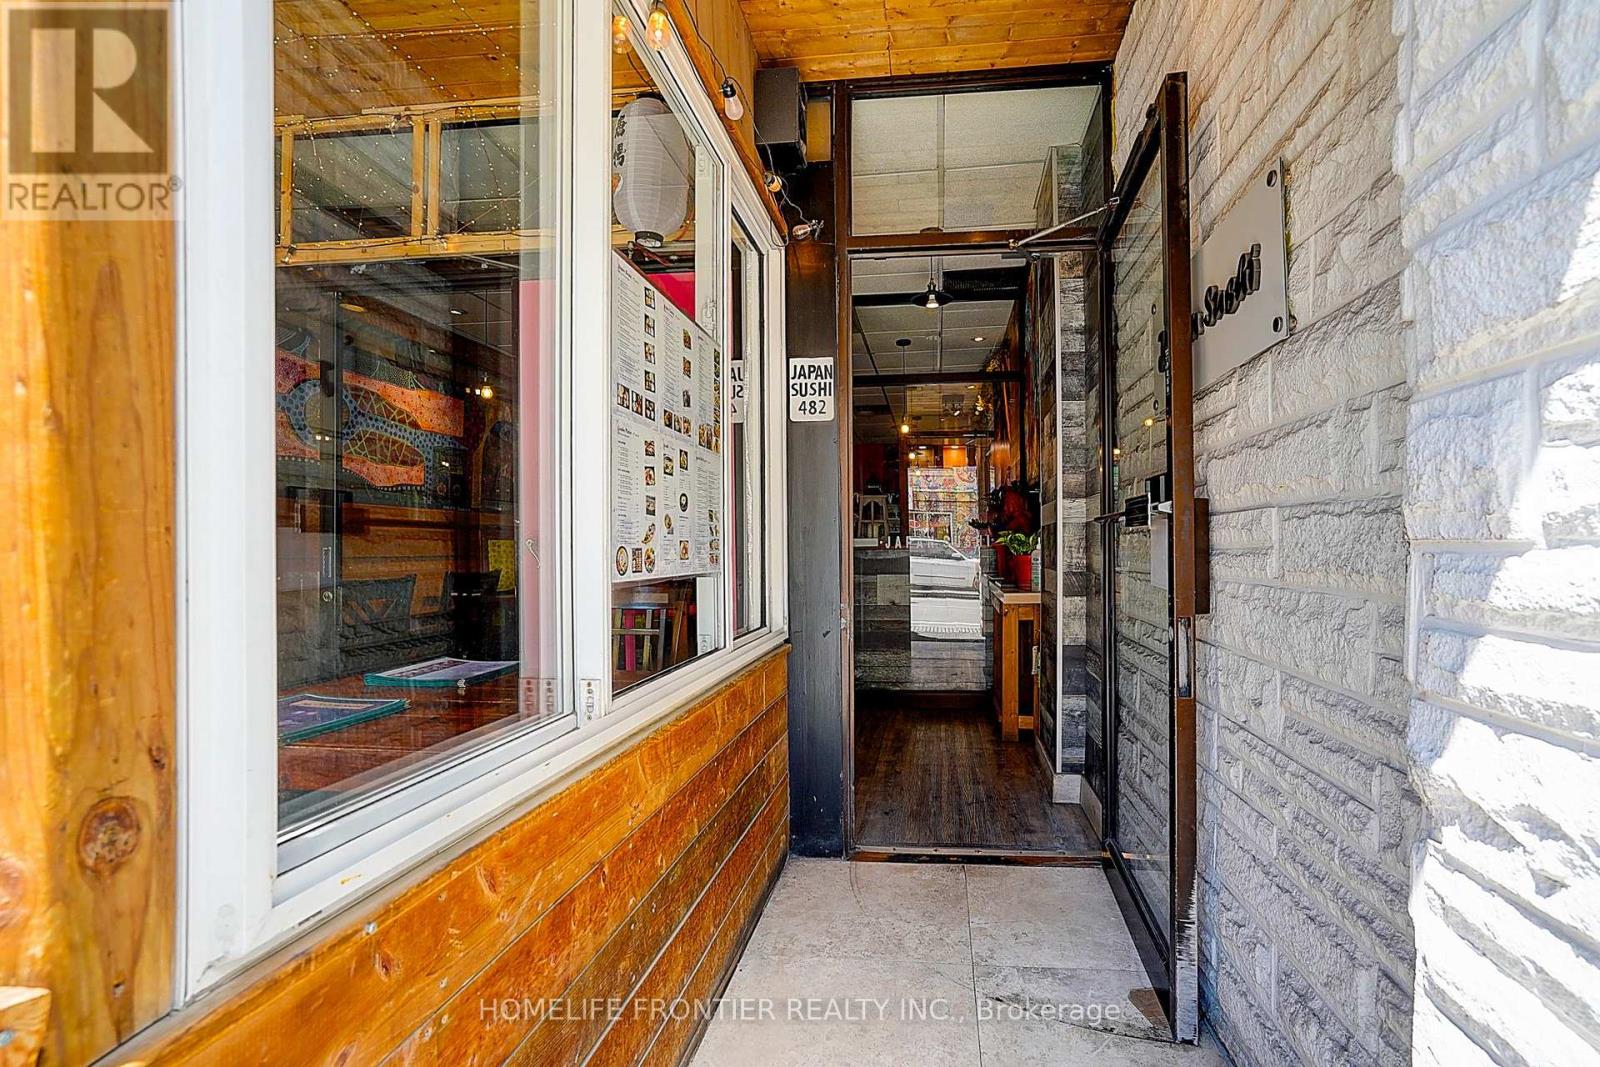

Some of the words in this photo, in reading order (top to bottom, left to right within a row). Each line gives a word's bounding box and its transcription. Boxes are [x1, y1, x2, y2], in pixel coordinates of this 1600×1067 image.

[790, 364, 833, 380] JAPAN
[790, 381, 833, 397] SUSHI
[798, 399, 827, 415] 482
